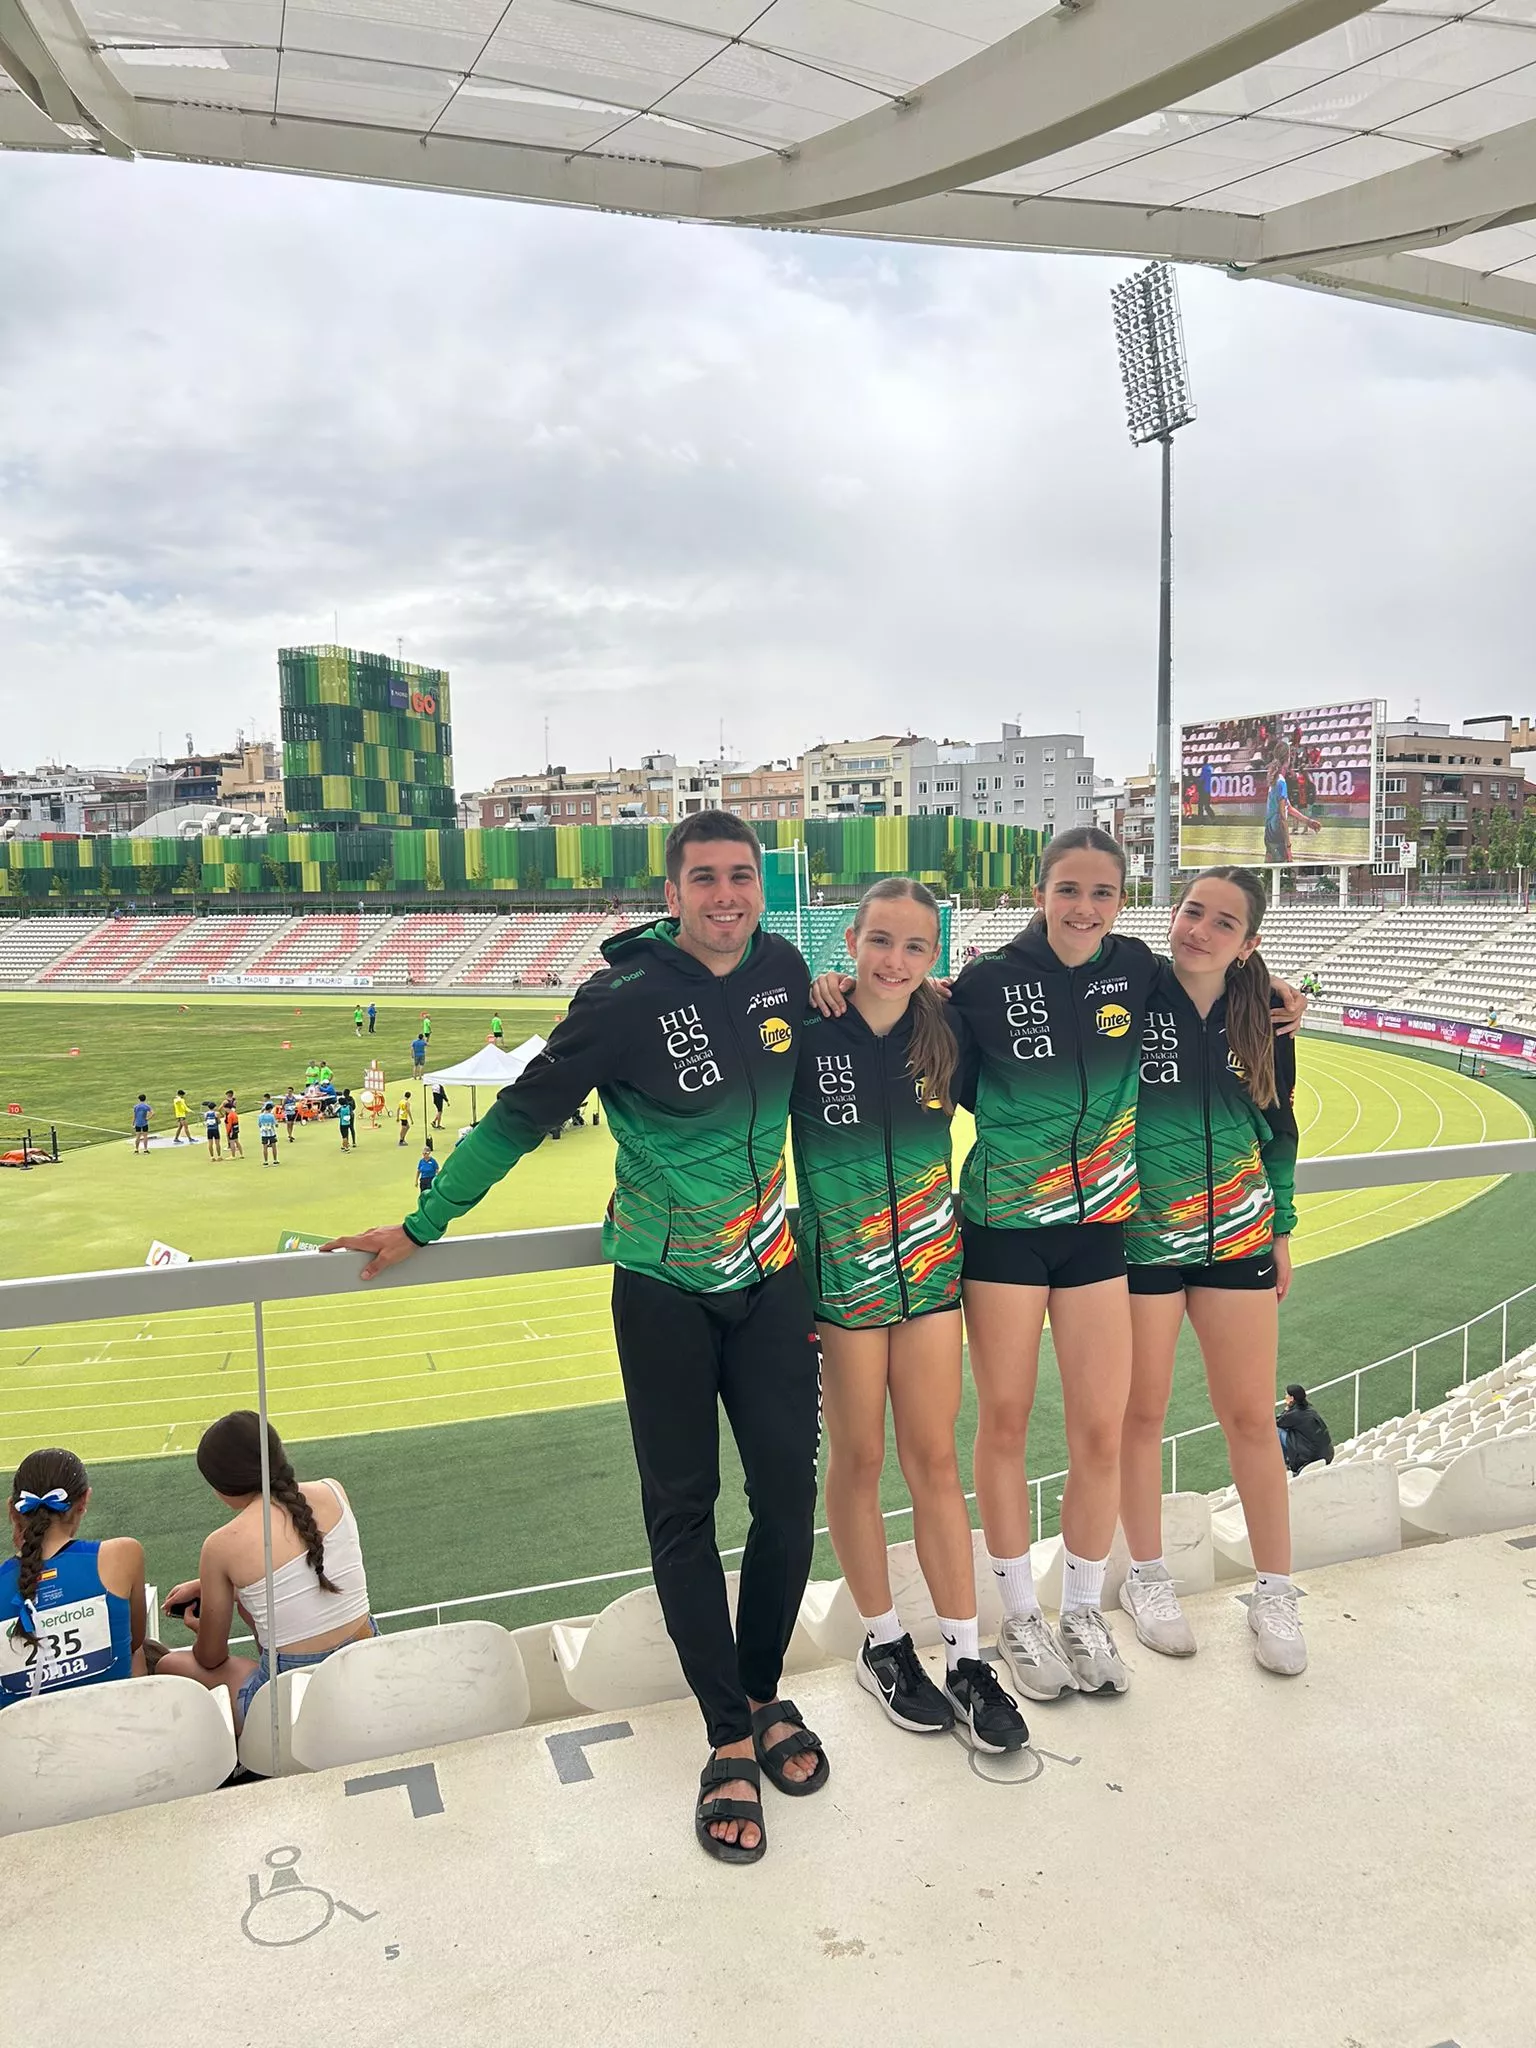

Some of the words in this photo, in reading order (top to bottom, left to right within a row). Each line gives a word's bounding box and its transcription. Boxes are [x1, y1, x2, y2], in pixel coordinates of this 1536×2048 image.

[412, 691, 436, 714] GO
[1210, 775, 1257, 797] oma
[1312, 770, 1355, 796] ma
[762, 992, 788, 1008] ZOITI
[385, 1944, 400, 1960] 5
